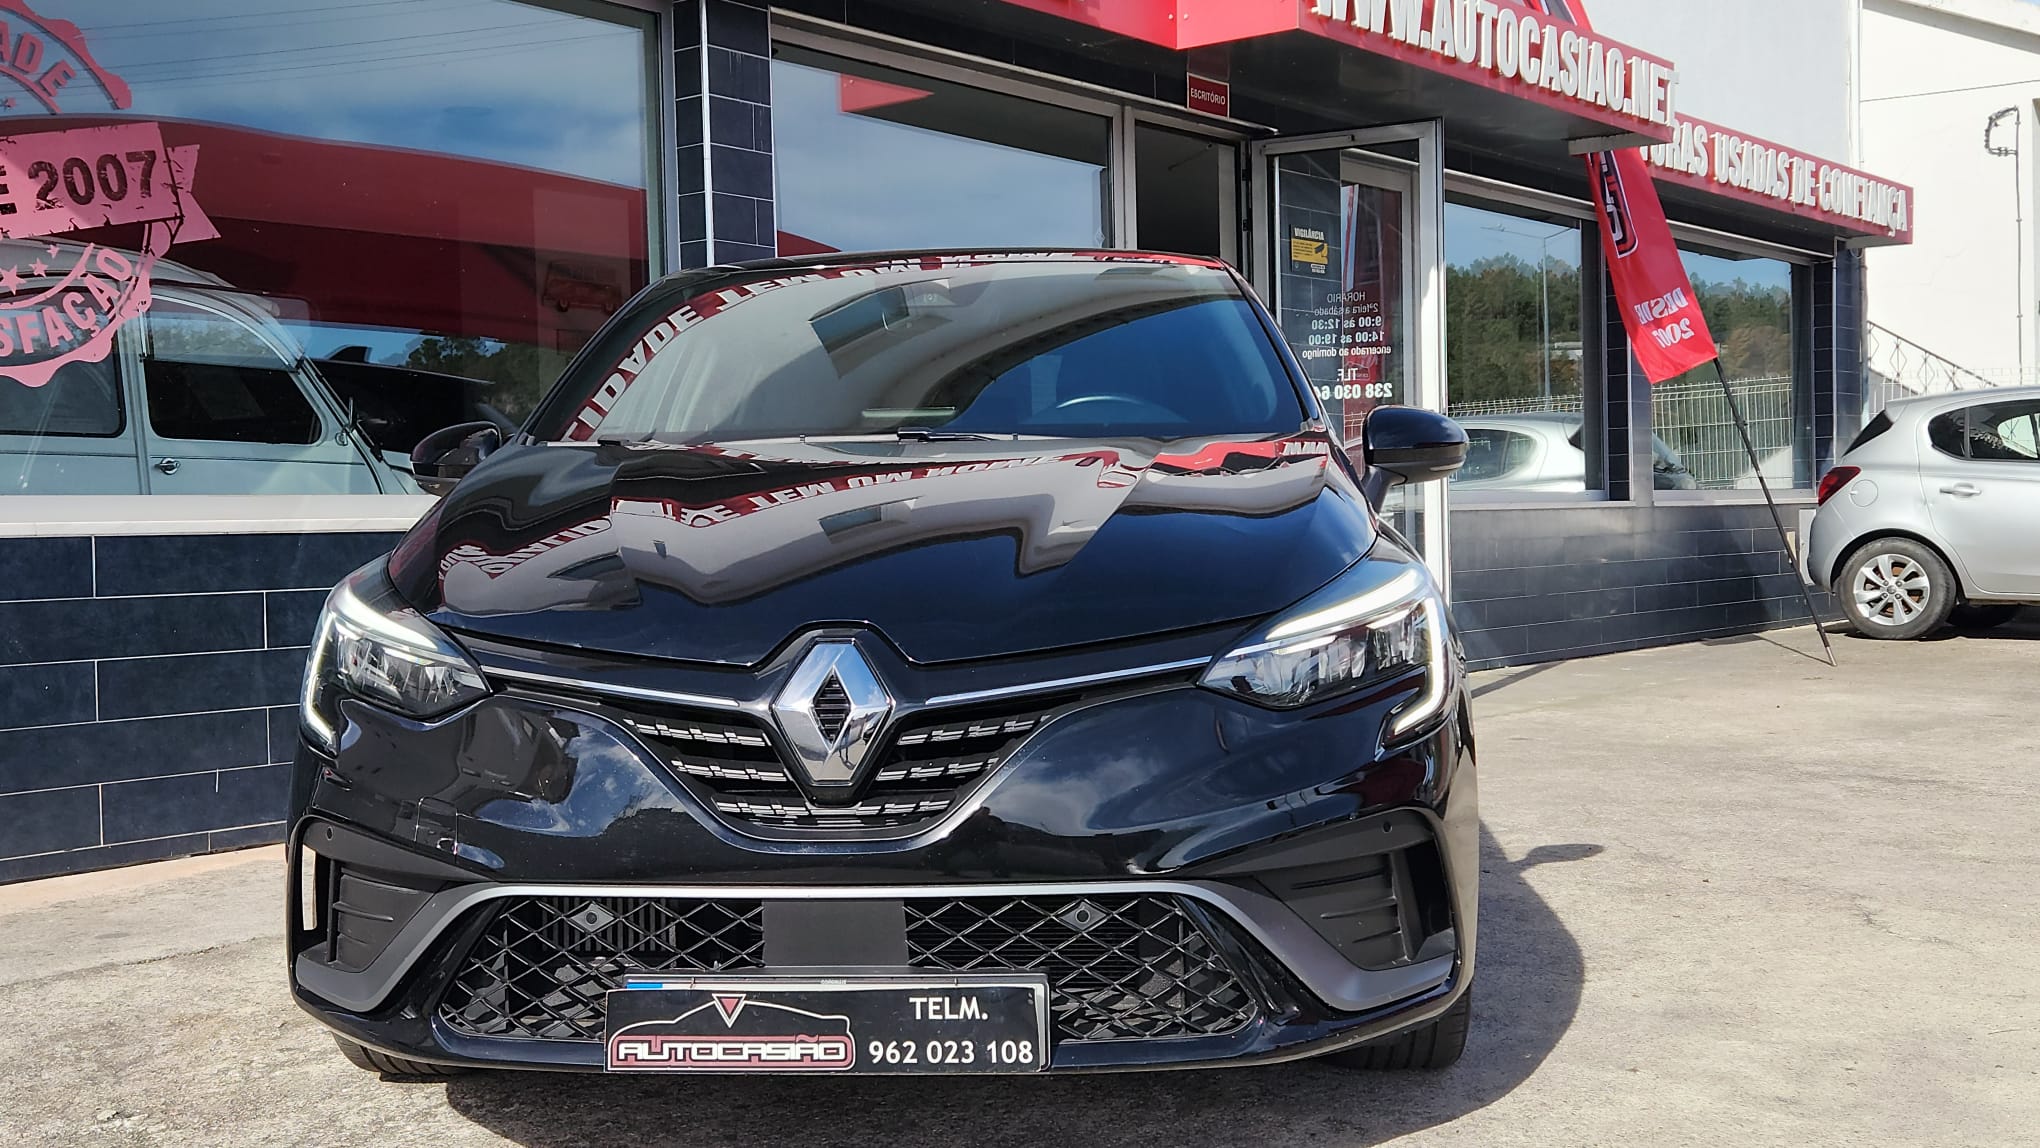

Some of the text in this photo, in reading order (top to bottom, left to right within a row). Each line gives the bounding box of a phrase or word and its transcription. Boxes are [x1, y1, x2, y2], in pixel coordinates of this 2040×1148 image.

[1311, 0, 1679, 126] W.AUTOCASIAO.NET
[1190, 87, 1226, 105] ESCRITÓRIO
[28, 150, 157, 211] 2007
[1710, 131, 1790, 200] USADAS
[1789, 157, 1816, 206] DE
[1816, 165, 1908, 236] CONFIANÇA
[908, 996, 989, 1021] TELM.
[618, 1034, 847, 1061] AUTOCASIÃO
[868, 1040, 1034, 1064] 962 023 108
